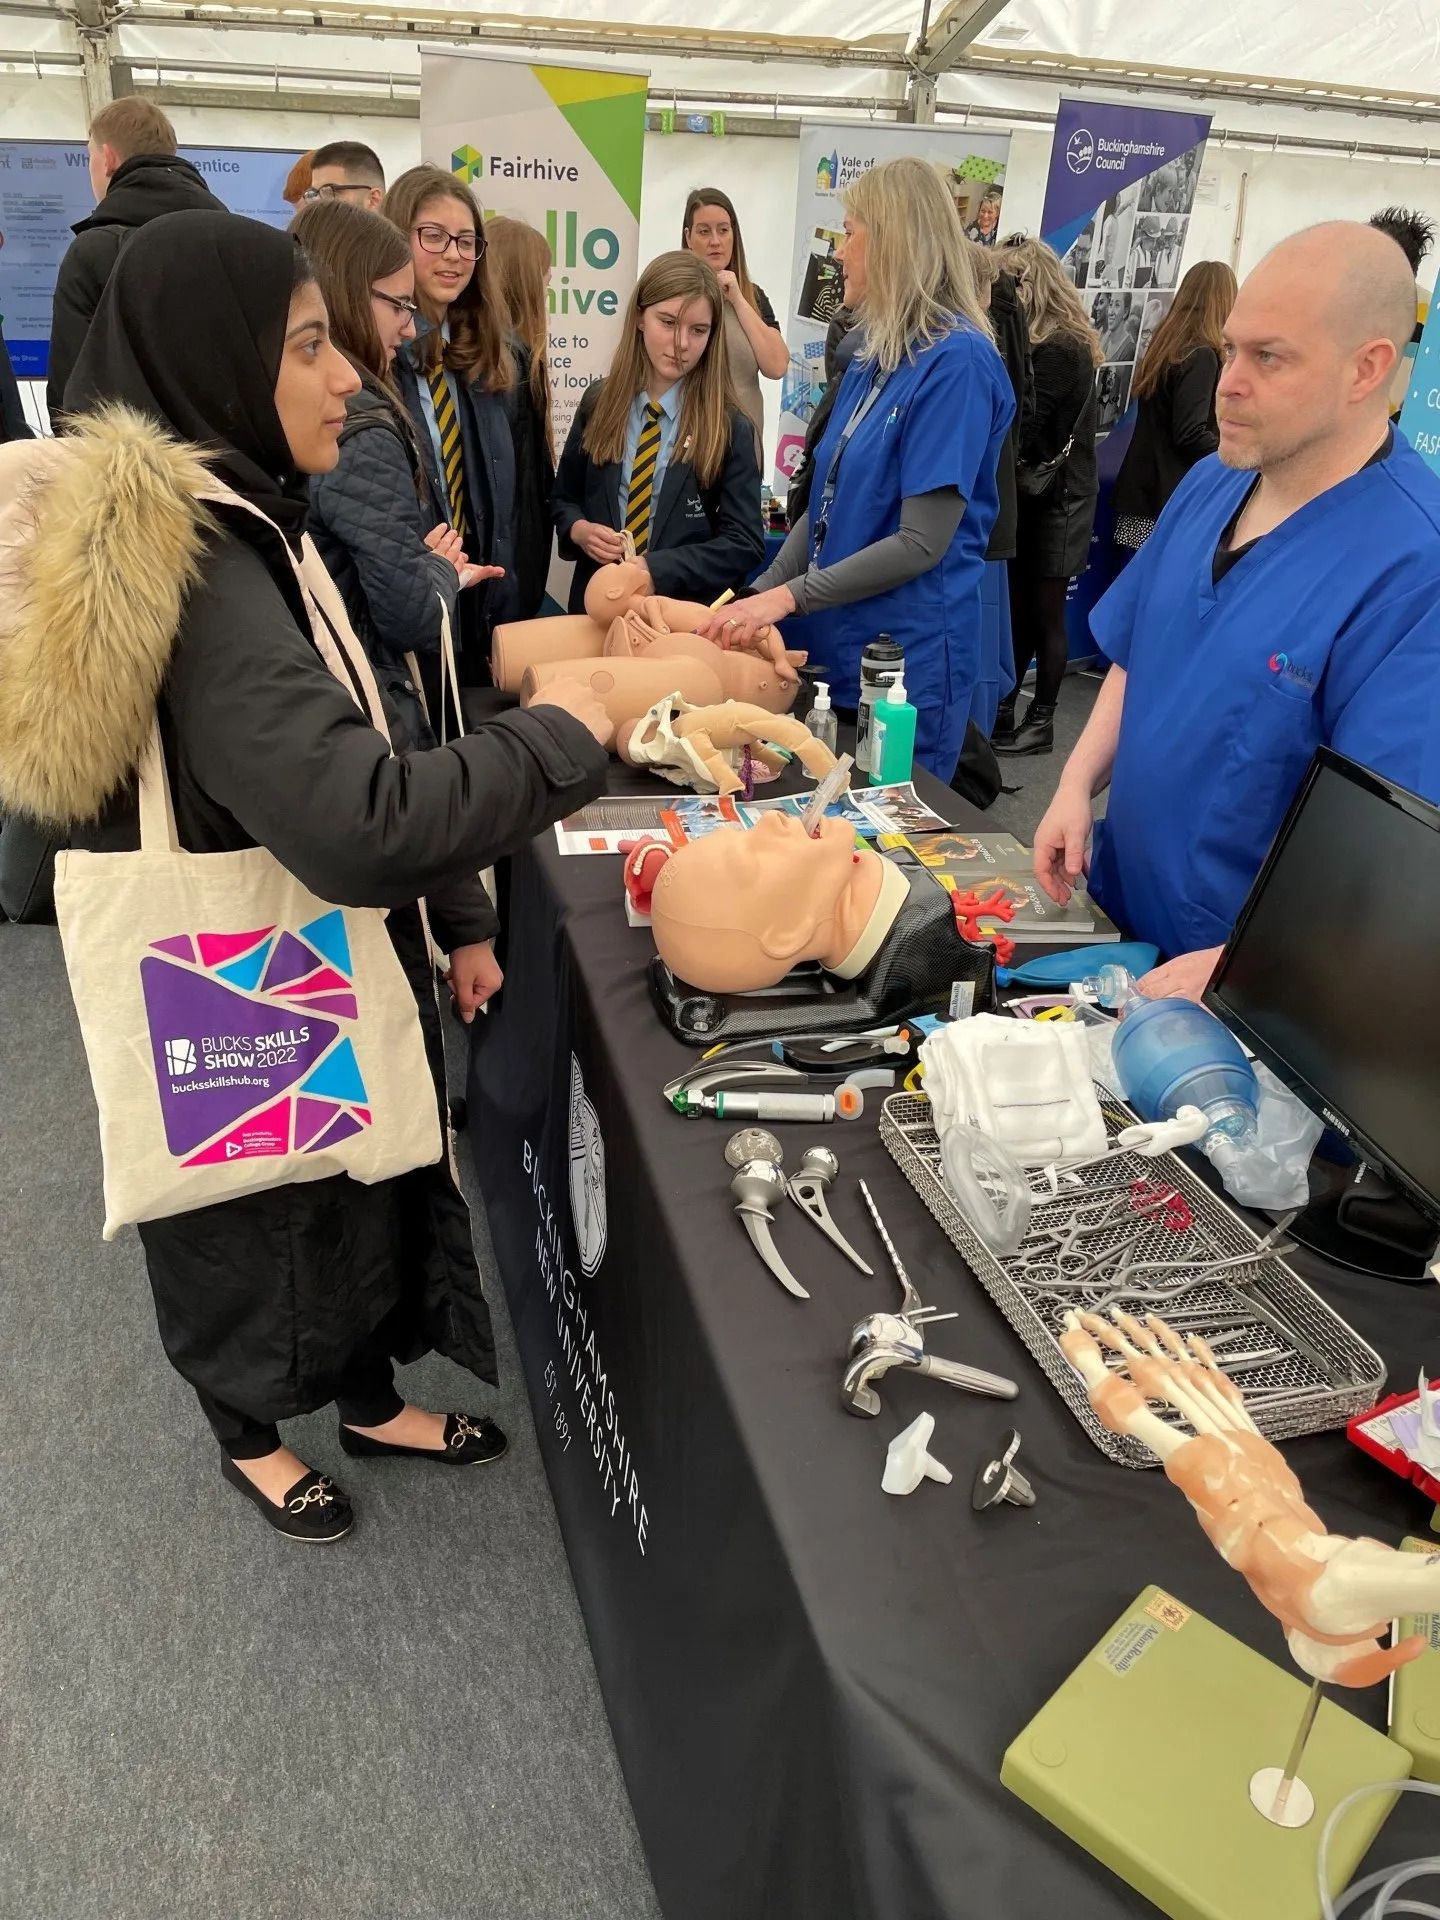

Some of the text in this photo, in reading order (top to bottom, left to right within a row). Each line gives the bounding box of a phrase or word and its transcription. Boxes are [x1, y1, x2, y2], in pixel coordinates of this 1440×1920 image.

[1097, 138, 1166, 157] Buckinghamshire
[193, 159, 240, 173] entice
[490, 156, 579, 182] Fairhive
[841, 157, 875, 168] Vale of
[1095, 156, 1126, 171] Council
[545, 209, 620, 270] llo
[548, 334, 589, 349] ke to
[553, 413, 572, 423] sing
[201, 1026, 310, 1053] BUCKS SKILLS
[204, 1046, 298, 1070] SHOW 2022
[172, 1074, 270, 1094] bucksskillshub.org
[1322, 1107, 1350, 1136] SAMSUNG
[523, 1139, 649, 1556] BUCKINGHAMSHIRE
[535, 1225, 620, 1518] NEW UNIVERSITY
[554, 1402, 571, 1452] 1891
